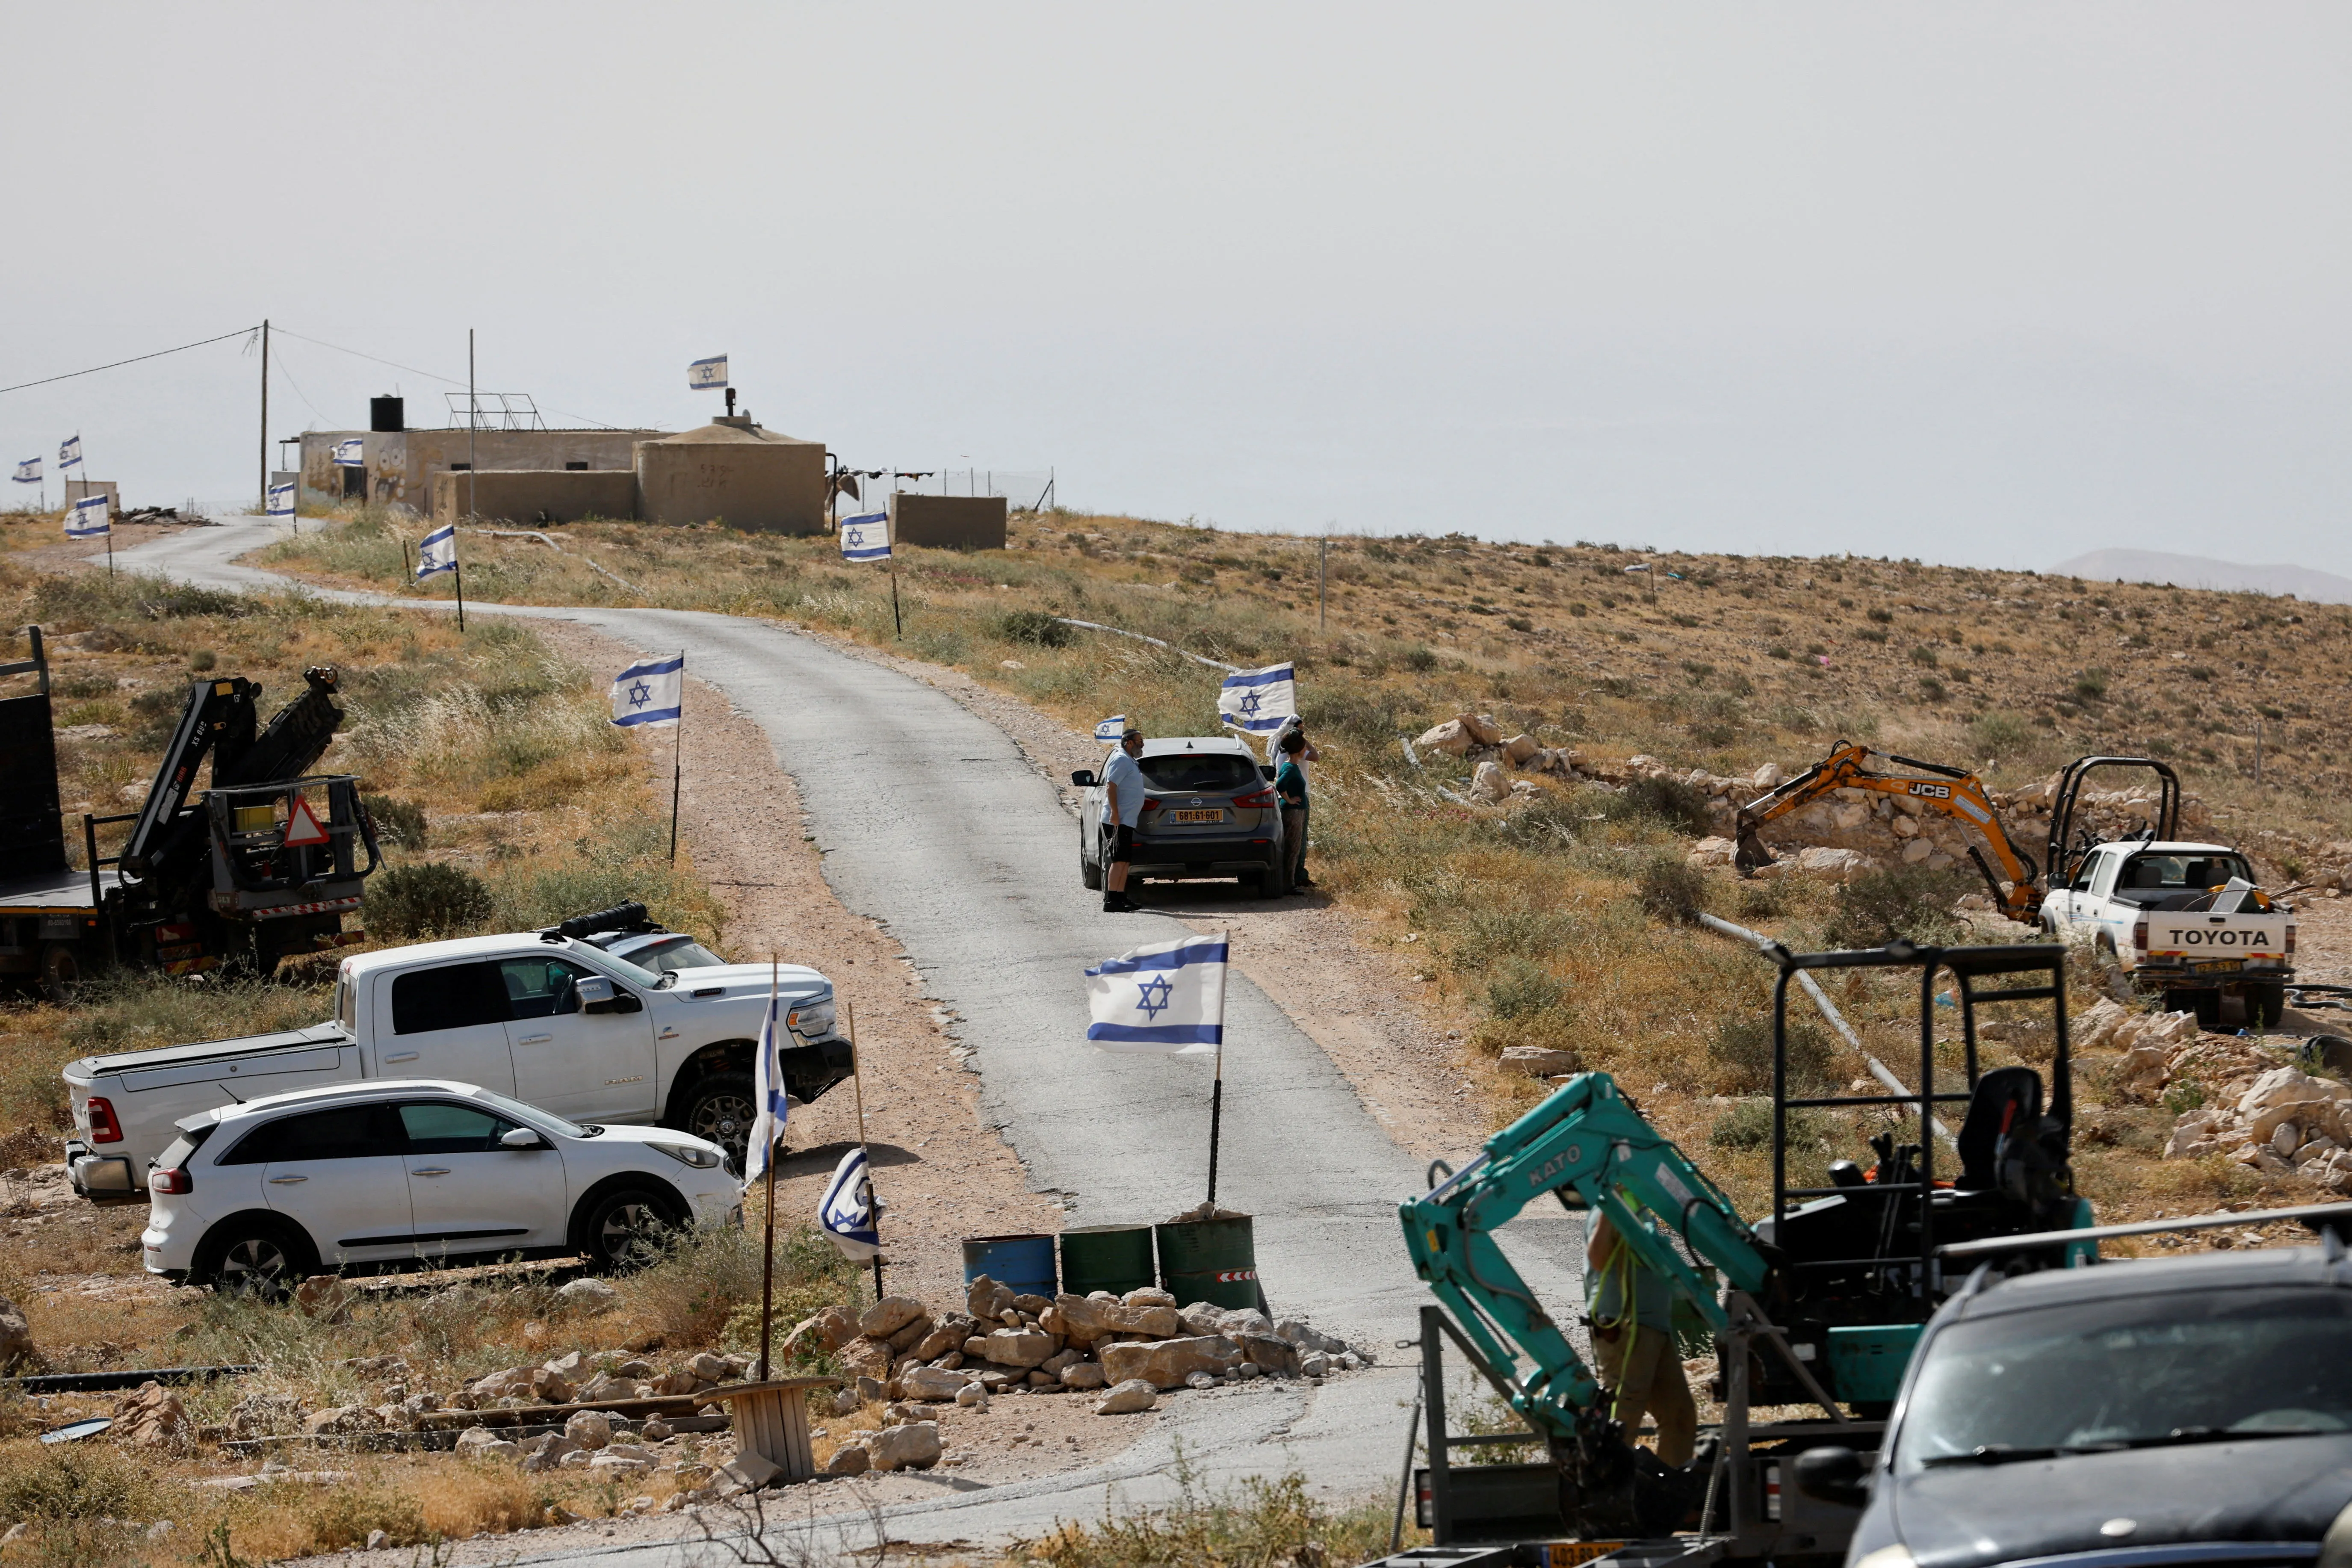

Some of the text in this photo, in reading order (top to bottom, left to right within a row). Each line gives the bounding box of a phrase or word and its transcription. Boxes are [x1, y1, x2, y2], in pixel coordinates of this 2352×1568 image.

[191, 736, 200, 747] XS
[176, 766, 187, 783] HIAB
[1909, 783, 1950, 799] JCB
[2169, 930, 2269, 946] TOYOTA
[605, 1075, 643, 1085] RAM
[1529, 1144, 1581, 1187] KATO
